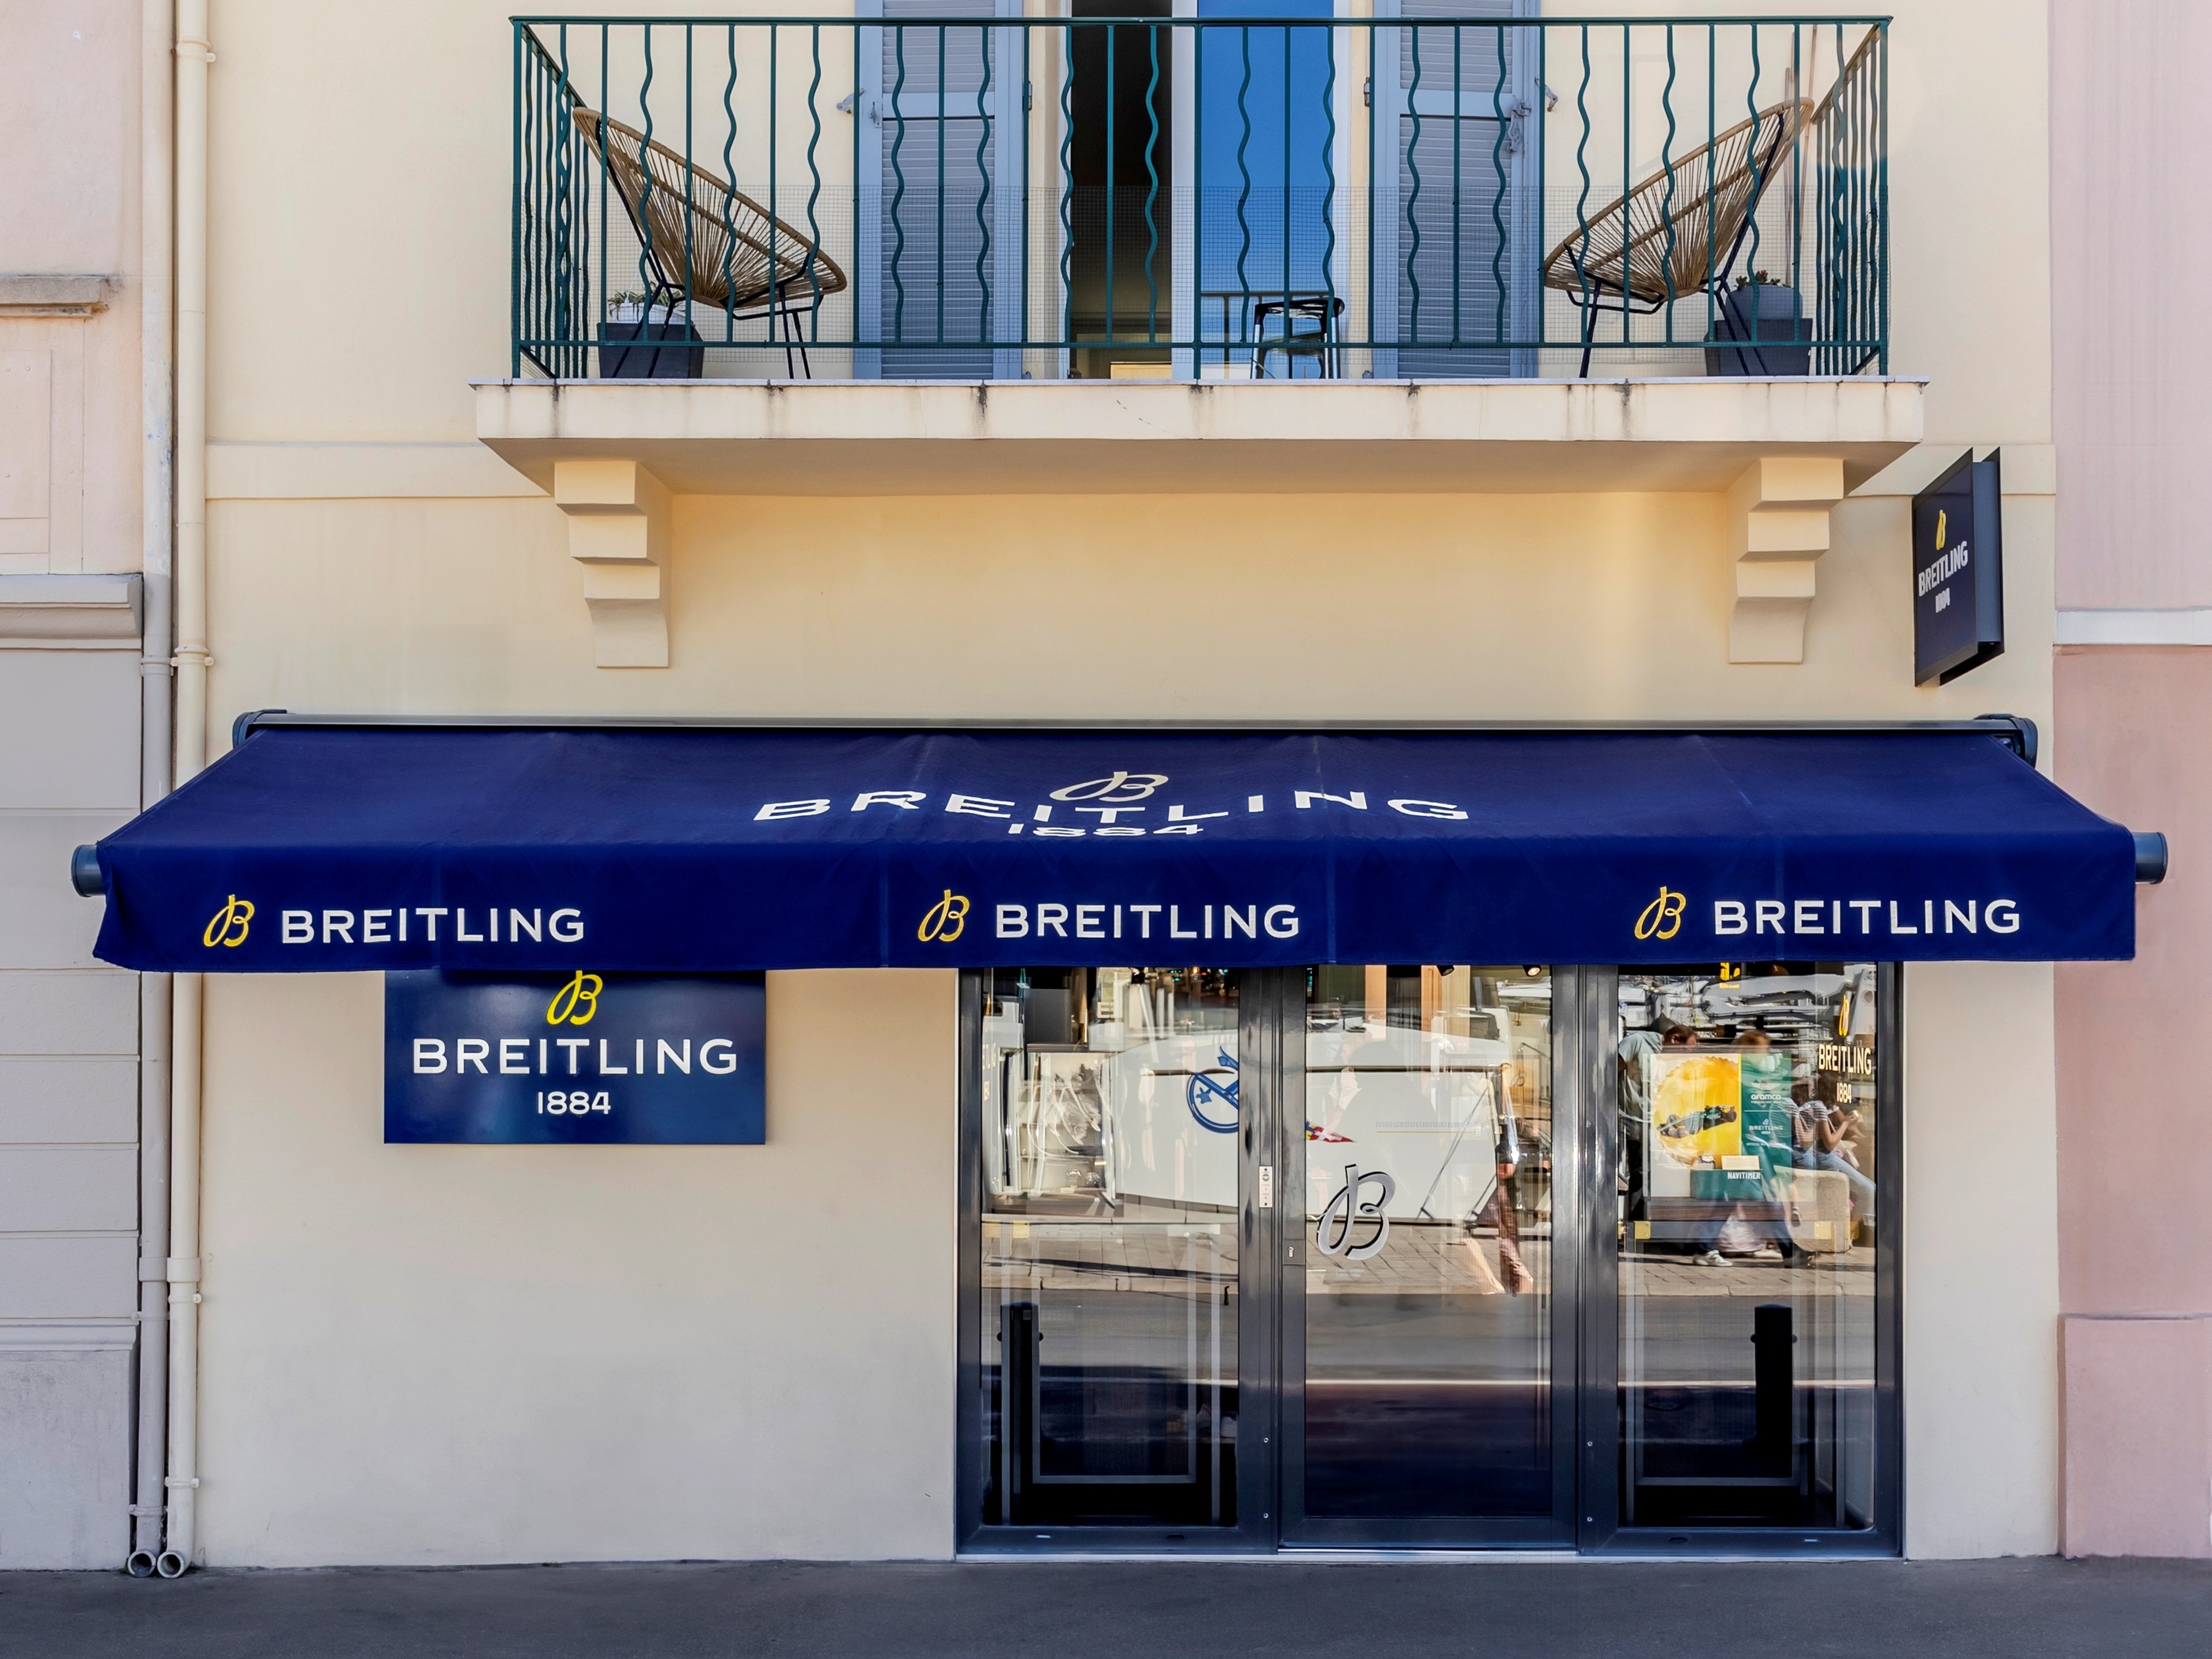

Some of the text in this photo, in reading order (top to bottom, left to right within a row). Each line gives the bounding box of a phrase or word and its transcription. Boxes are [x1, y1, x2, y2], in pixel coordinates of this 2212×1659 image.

[1918, 540, 1968, 597] BREITLING
[753, 791, 1469, 823] BREITLING
[1008, 824, 1204, 837] 1884
[282, 907, 585, 944] BREITLING
[996, 903, 1300, 939] BREITLING
[1714, 899, 2020, 935] BREITLING
[413, 1038, 737, 1075] BREITLING
[1819, 1044, 1872, 1075] BREITLING
[537, 1091, 611, 1115] 1884
[1836, 1082, 1851, 1104] 1884
[1728, 1172, 1761, 1180] NAVITIMER
